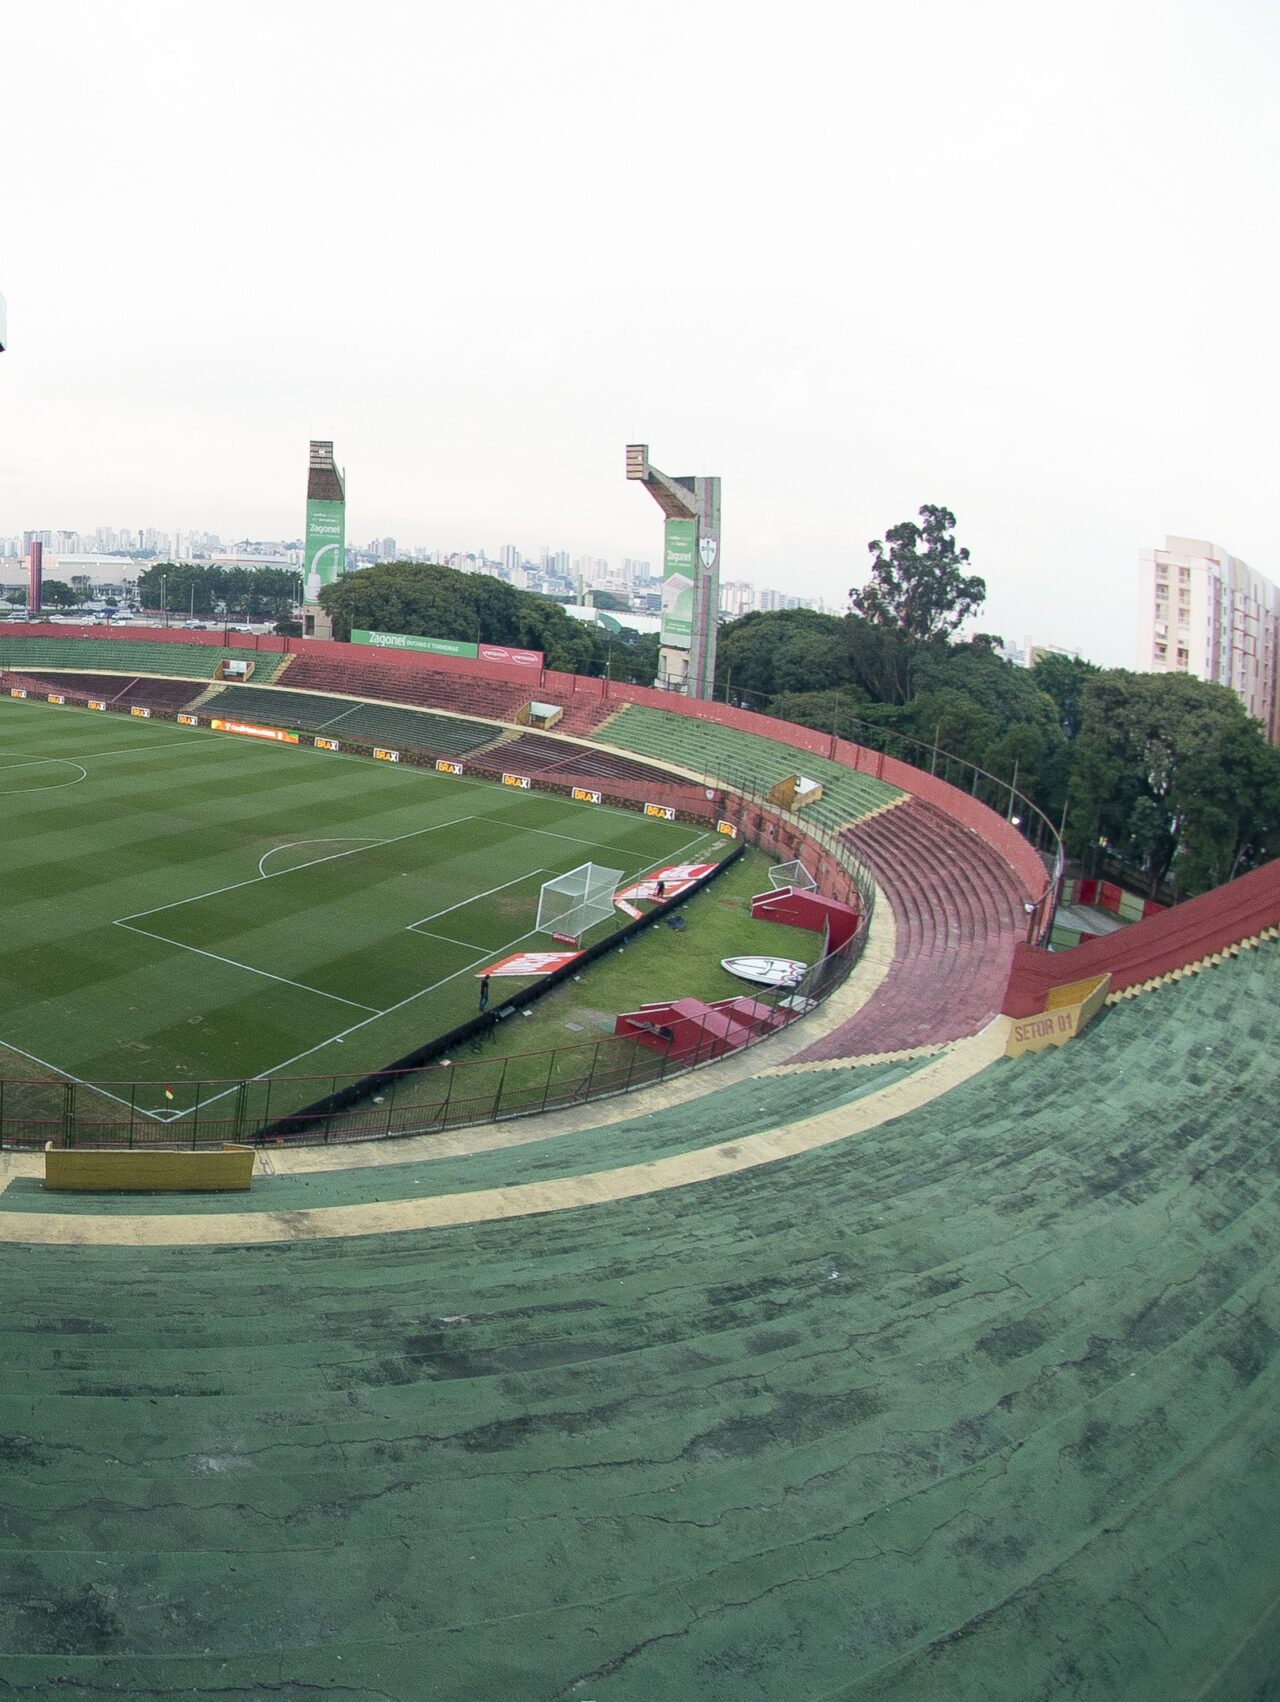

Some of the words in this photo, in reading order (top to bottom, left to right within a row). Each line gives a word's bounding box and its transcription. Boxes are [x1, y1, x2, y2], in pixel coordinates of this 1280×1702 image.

[310, 523, 340, 534] Zagonel
[368, 631, 406, 647] Zagonel
[317, 740, 336, 750] BRAX
[376, 752, 397, 762] BRAX
[439, 763, 459, 774] BRAX
[505, 776, 528, 788] BRAX
[575, 790, 598, 803] BRAX
[647, 807, 672, 820] BRAX
[1015, 1018, 1055, 1042] SETOR
[1057, 1013, 1072, 1032] 01
